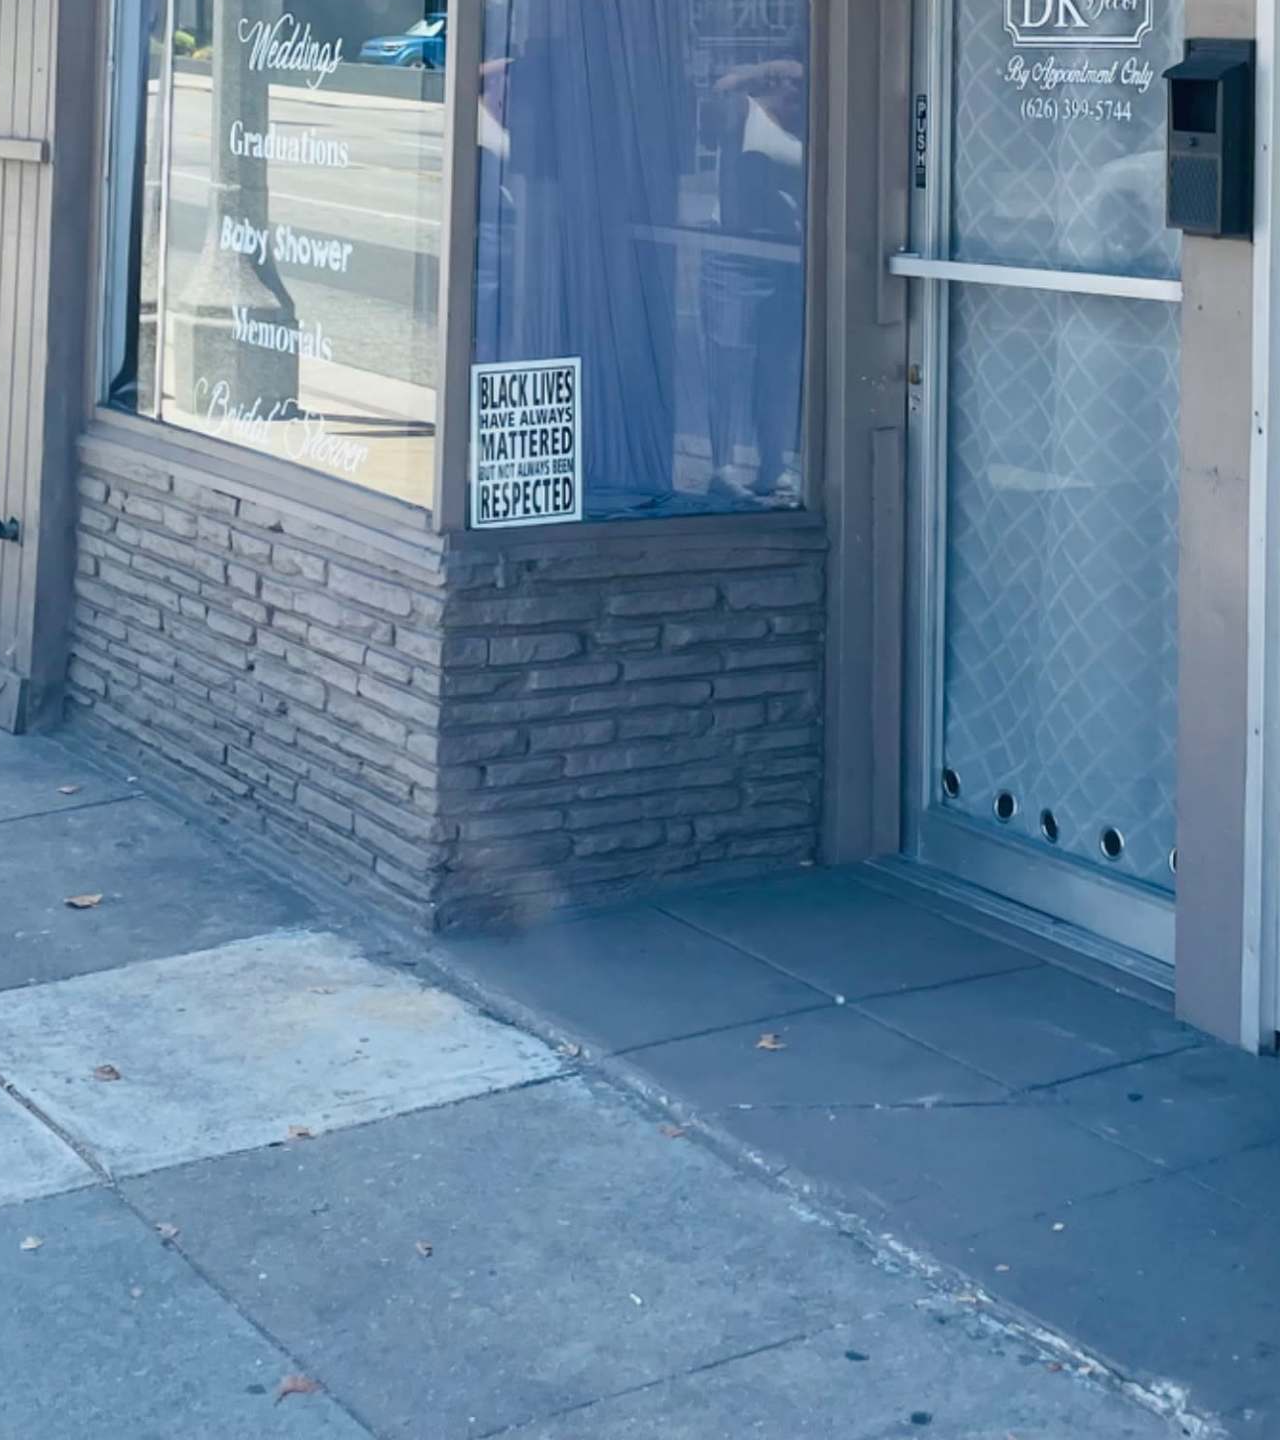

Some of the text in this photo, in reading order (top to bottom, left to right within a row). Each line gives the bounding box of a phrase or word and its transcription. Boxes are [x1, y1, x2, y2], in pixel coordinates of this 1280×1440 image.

[237, 13, 344, 89] Weddings
[1004, 54, 1154, 94] By Appointment Only
[1020, 97, 1133, 123] (626) 399-5744
[229, 119, 350, 169] Graduations
[220, 215, 354, 273] Baby Shower
[231, 303, 334, 362] Memorials
[481, 369, 574, 410] BLACK LIVES
[193, 375, 369, 474] Bridal Shower
[480, 407, 573, 430] HAVE ALWAYS
[481, 426, 574, 461] MATTERED
[479, 462, 496, 481] BUT
[518, 459, 550, 477] ALWAYS
[552, 458, 575, 475] BEEN
[481, 477, 574, 520] RESPECTED
